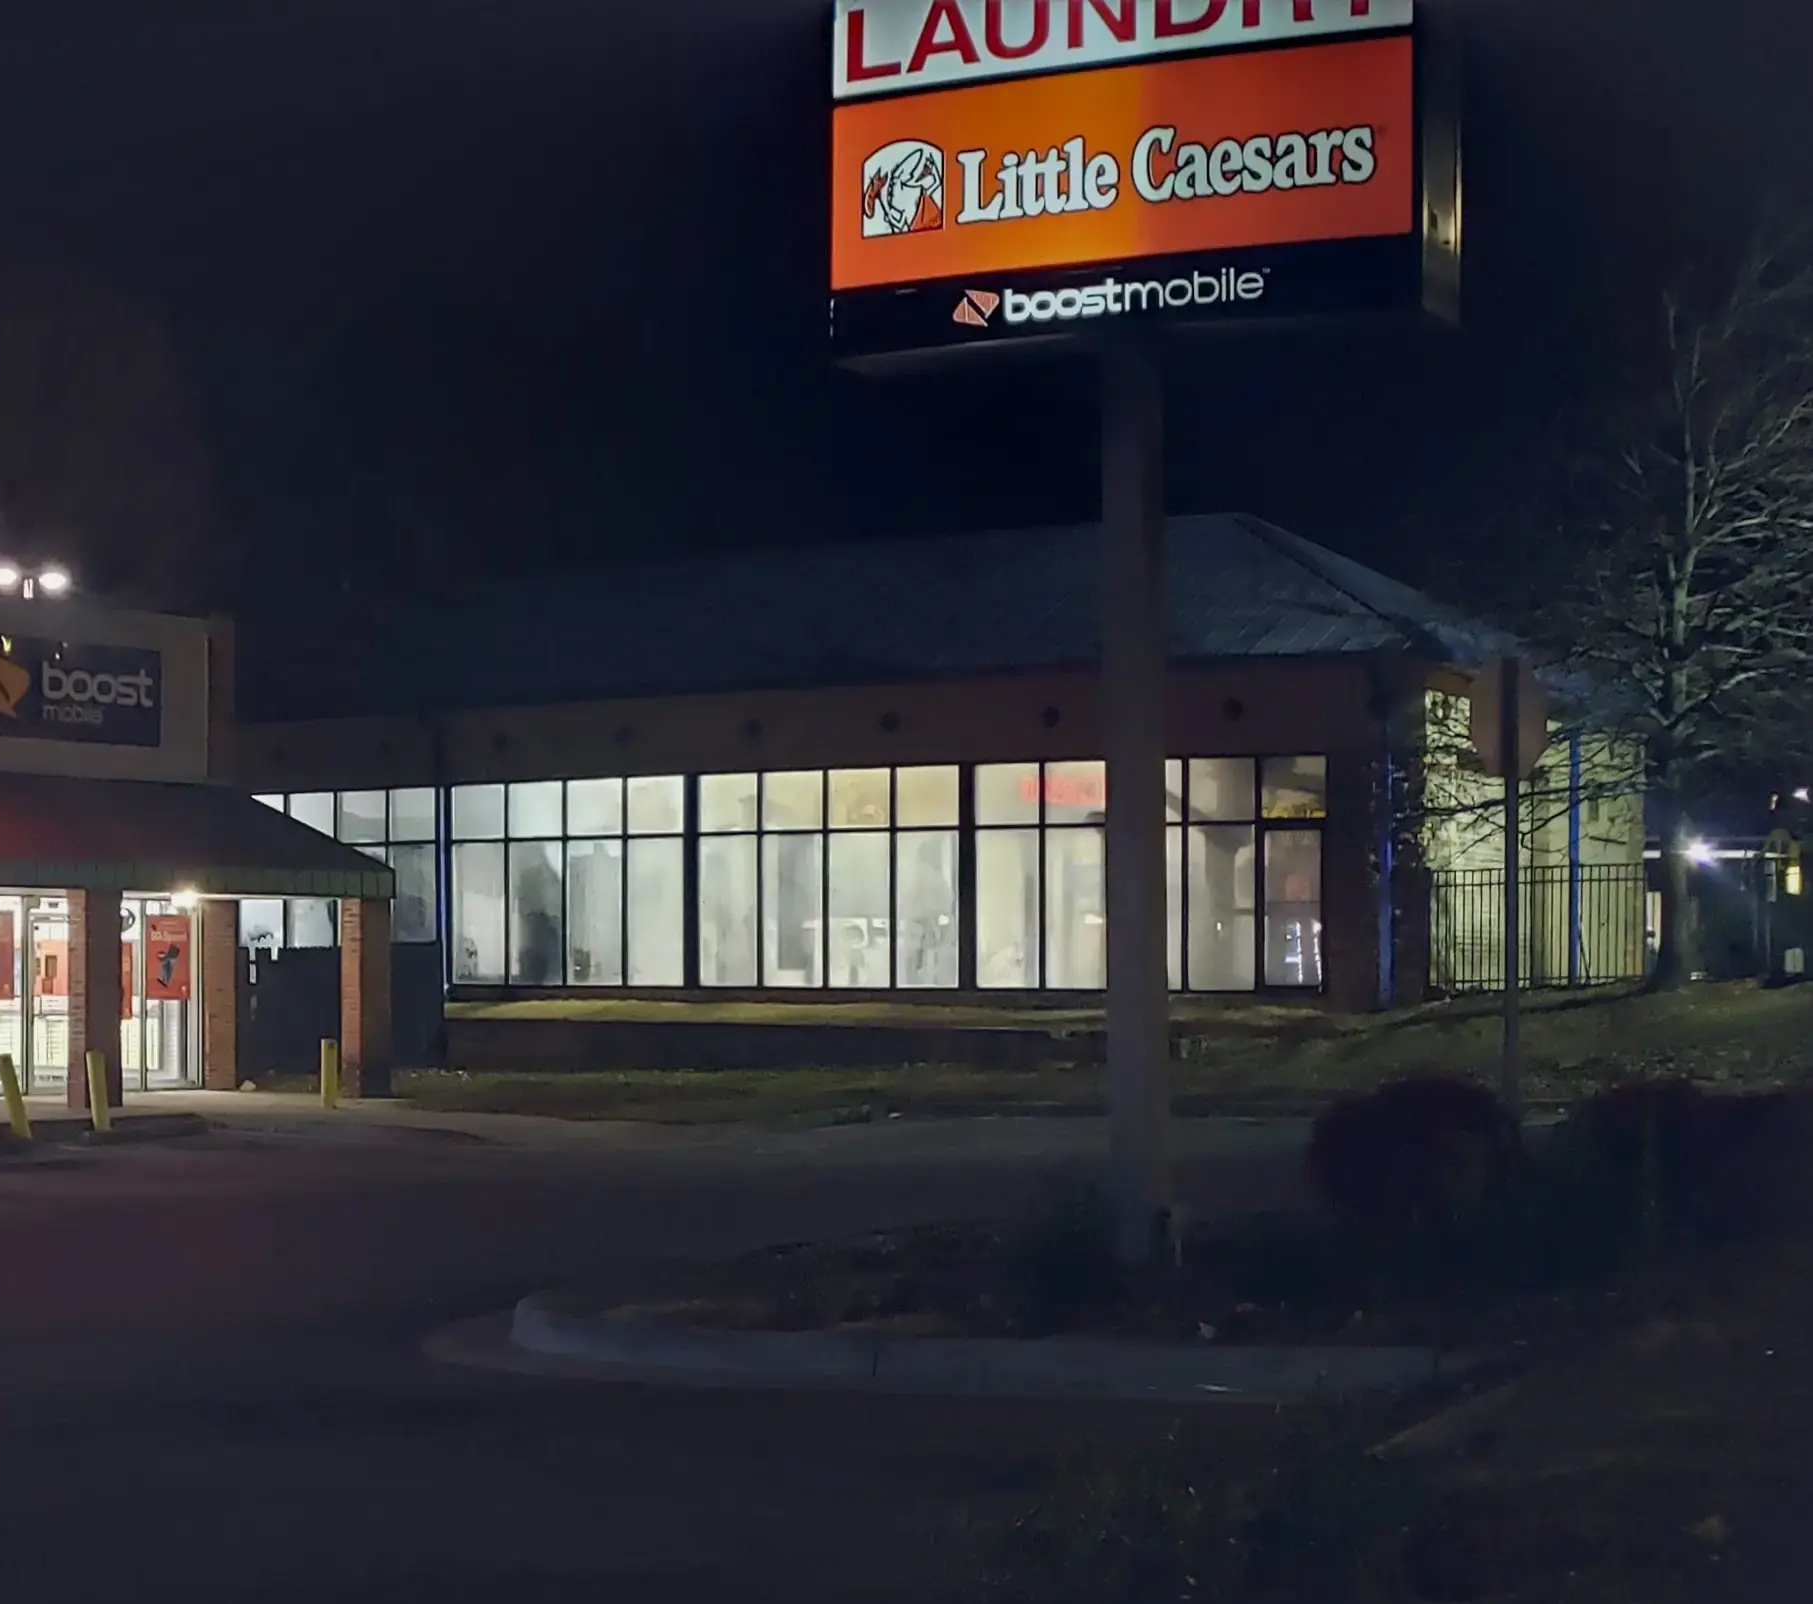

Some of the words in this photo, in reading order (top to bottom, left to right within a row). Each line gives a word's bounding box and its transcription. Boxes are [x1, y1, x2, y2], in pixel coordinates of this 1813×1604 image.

[846, 0, 1370, 82] LAUND
[955, 134, 1121, 225] Little
[1131, 125, 1377, 204] Caesars
[42, 661, 154, 708] boost
[43, 704, 104, 725] mobile
